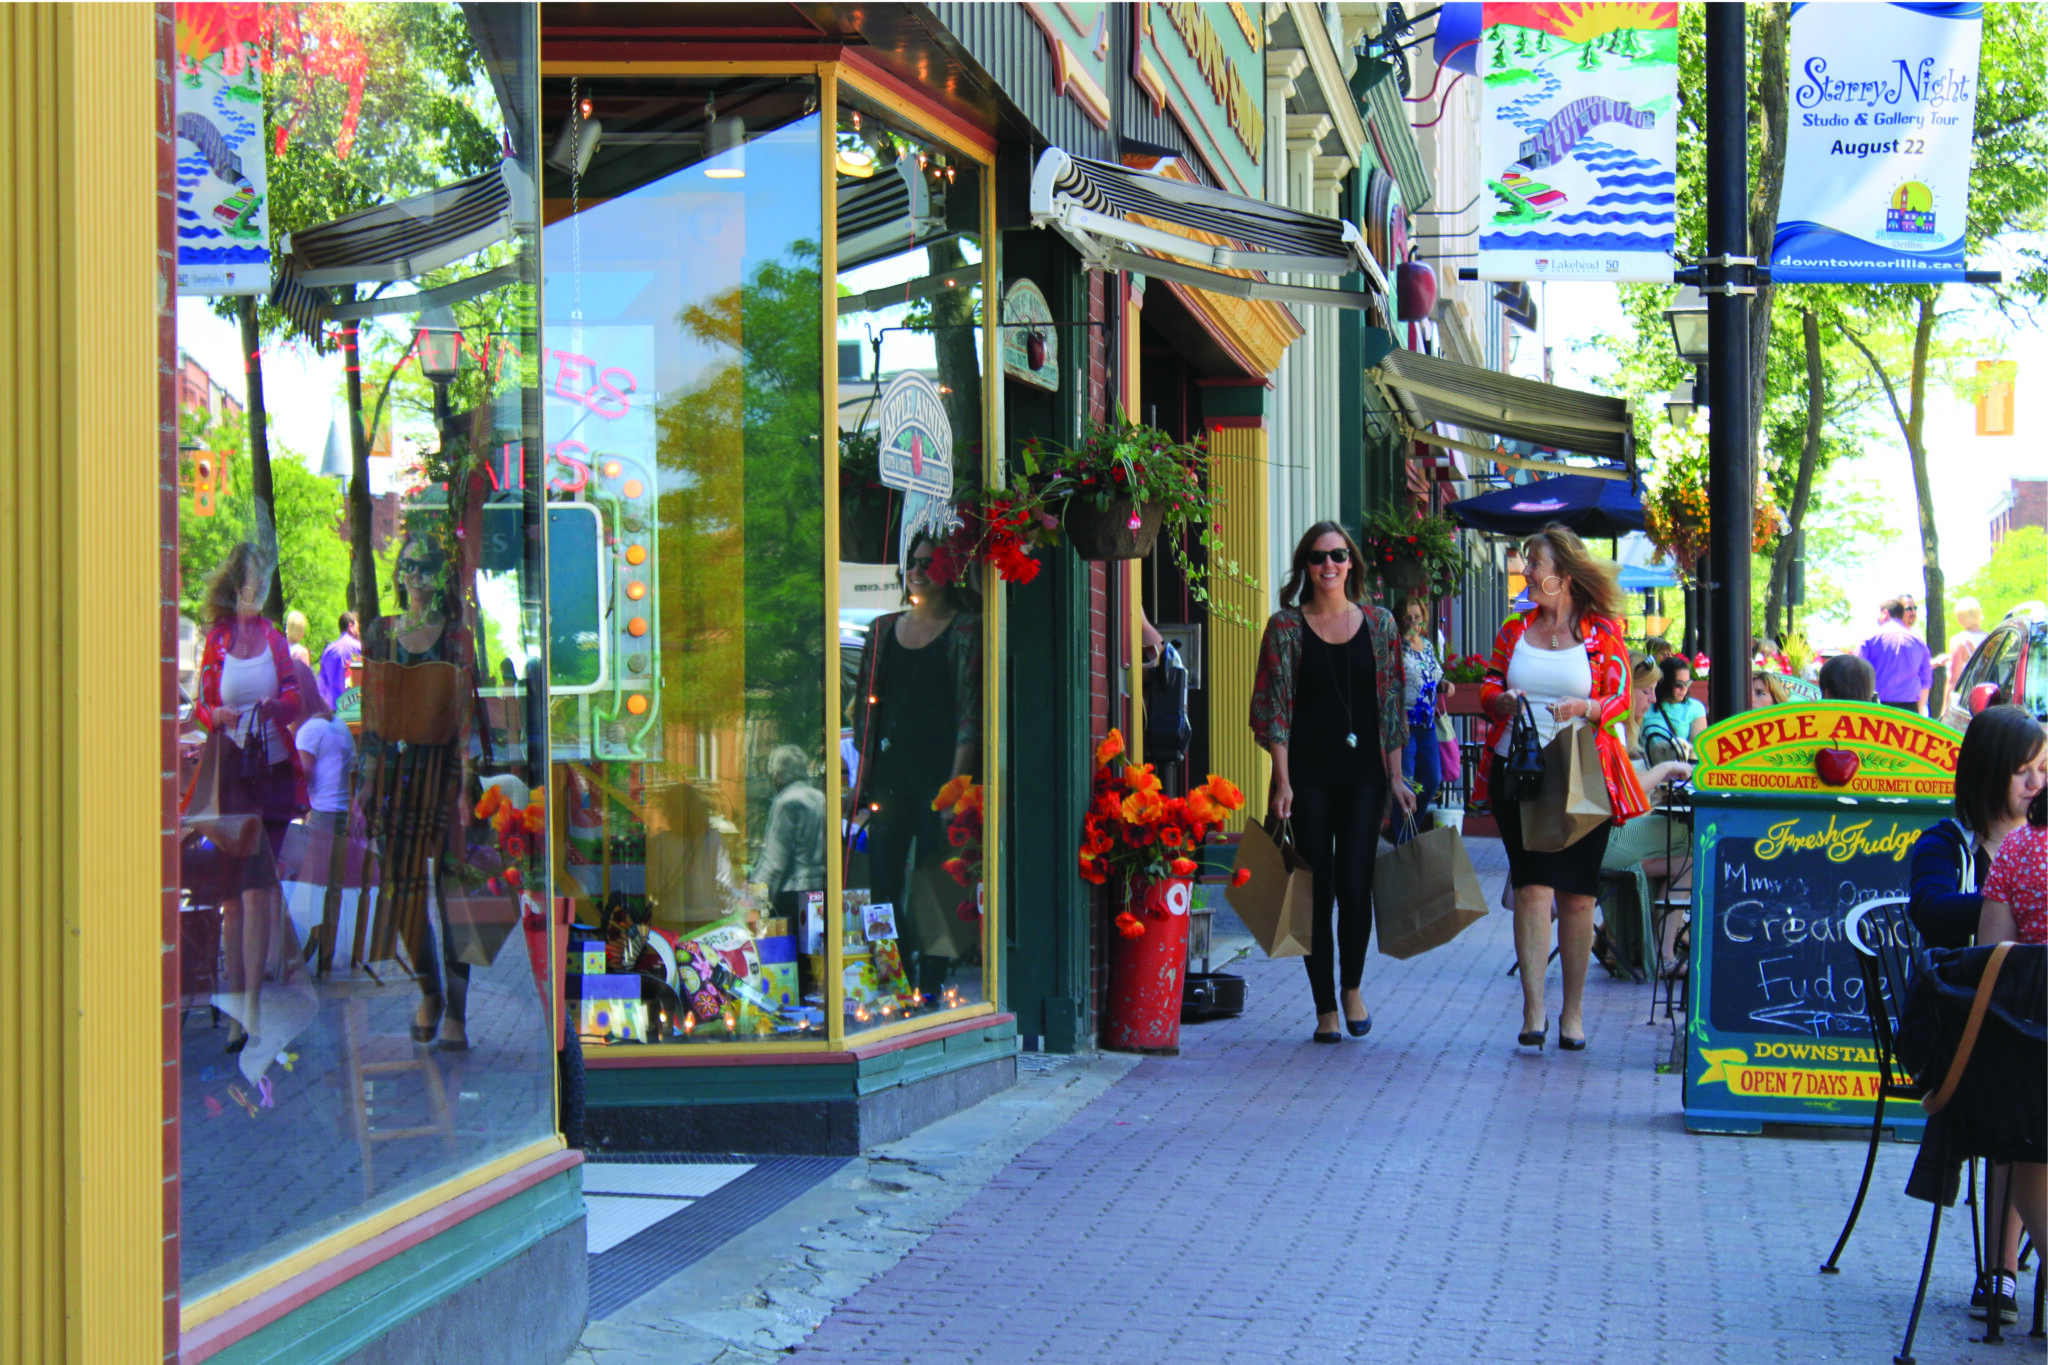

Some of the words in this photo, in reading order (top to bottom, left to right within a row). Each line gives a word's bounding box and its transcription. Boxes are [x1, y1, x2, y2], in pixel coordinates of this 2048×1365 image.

[1796, 57, 1887, 109] Starry
[1884, 58, 1970, 108] Night
[1803, 113, 1849, 127] Studio
[1854, 112, 1868, 126] &
[1874, 111, 1925, 130] Gallery
[1931, 111, 1959, 126] Tour
[1830, 139, 1899, 158] August
[1903, 139, 1925, 154] 22
[1551, 259, 1599, 270] Lakehead
[1605, 260, 1619, 270] 50
[1780, 256, 1953, 270] downtownorillia.ca
[885, 390, 913, 437] APPLE
[915, 390, 951, 462] ANNIE'S
[1715, 714, 1818, 766] APPLE
[1828, 715, 1961, 772] ANNIE'S
[1708, 773, 1737, 787] FINE
[1740, 774, 1818, 789] CHOCOLATE
[1852, 777, 1913, 793] GOURMET
[1754, 814, 1840, 860] Fresh
[1828, 819, 1921, 862] Fudge
[1741, 1070, 1787, 1093] OPEN
[1792, 1072, 1803, 1096] 7
[1807, 1074, 1848, 1096] DAYS
[1852, 1076, 1866, 1097] A
